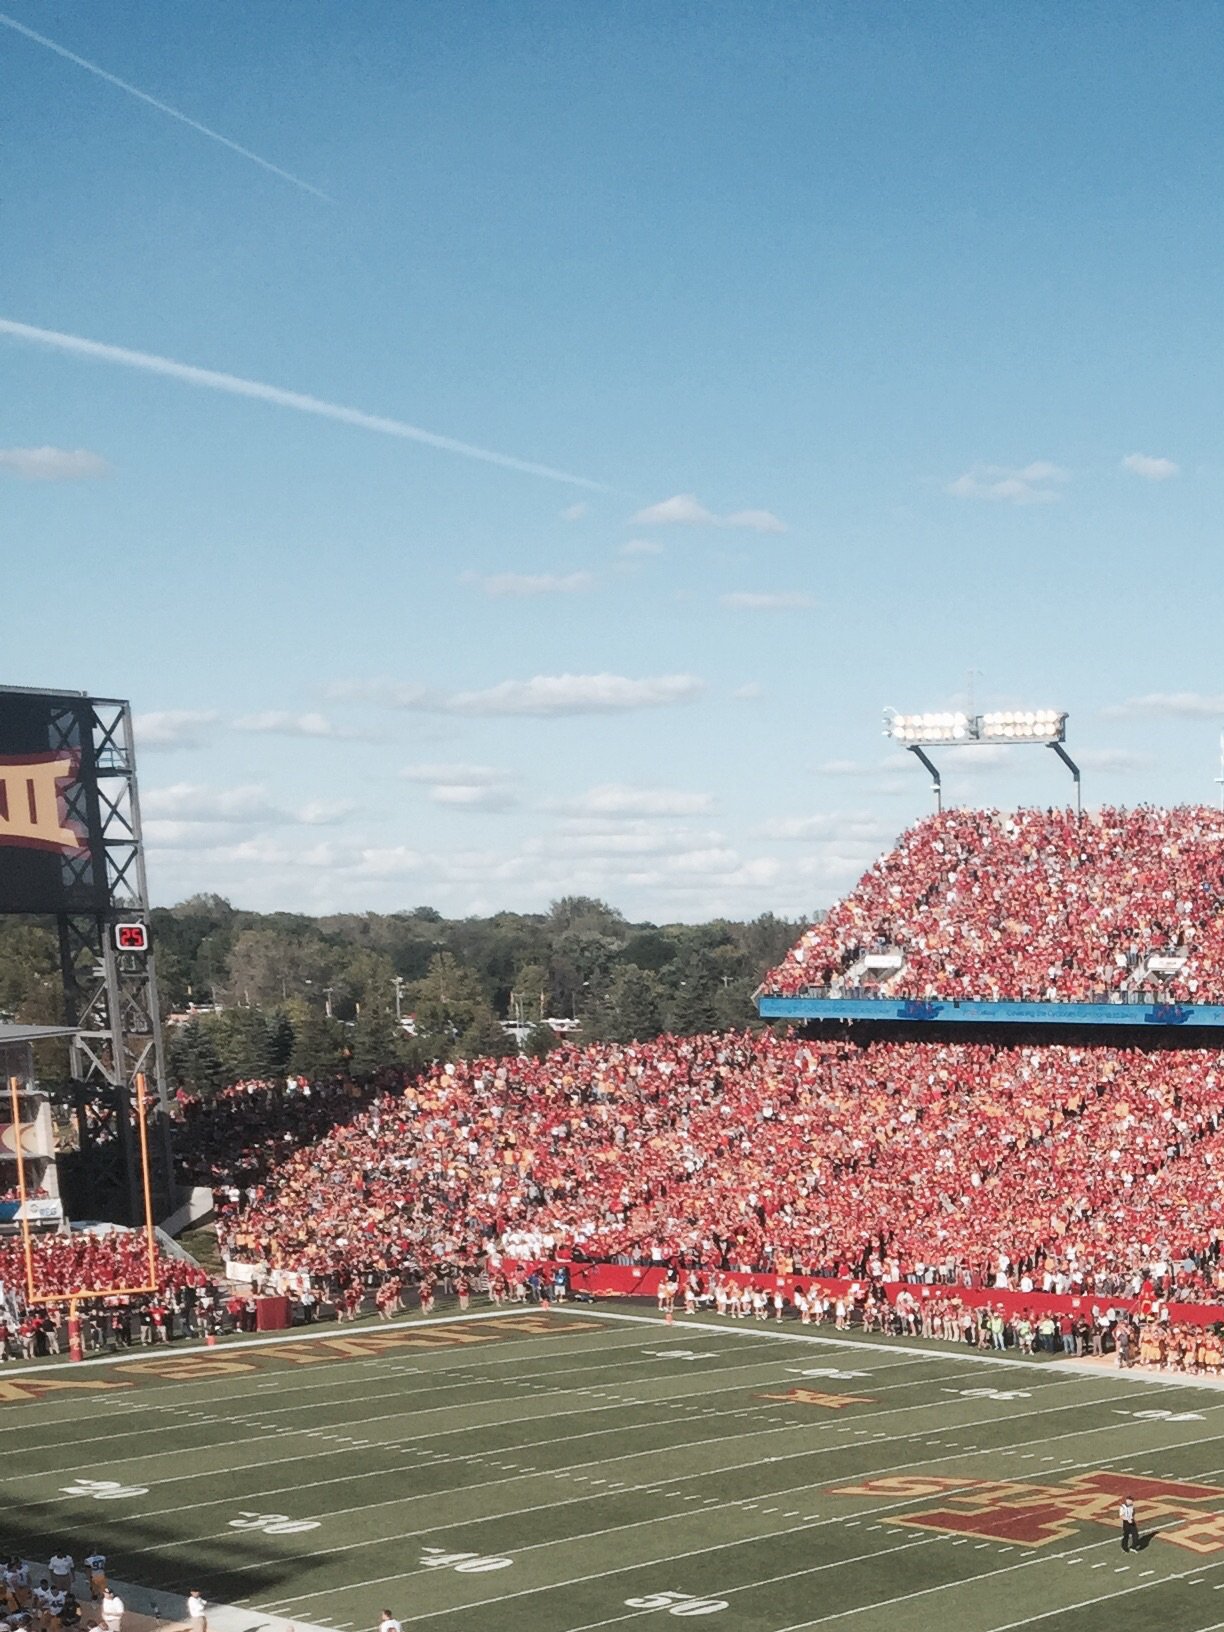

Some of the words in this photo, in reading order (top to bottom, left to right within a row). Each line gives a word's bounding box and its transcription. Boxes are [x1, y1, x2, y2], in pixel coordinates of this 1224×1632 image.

[121, 928, 144, 946] 25
[228, 1514, 321, 1534] 30
[419, 1552, 514, 1573] 40
[624, 1591, 730, 1616] 50
